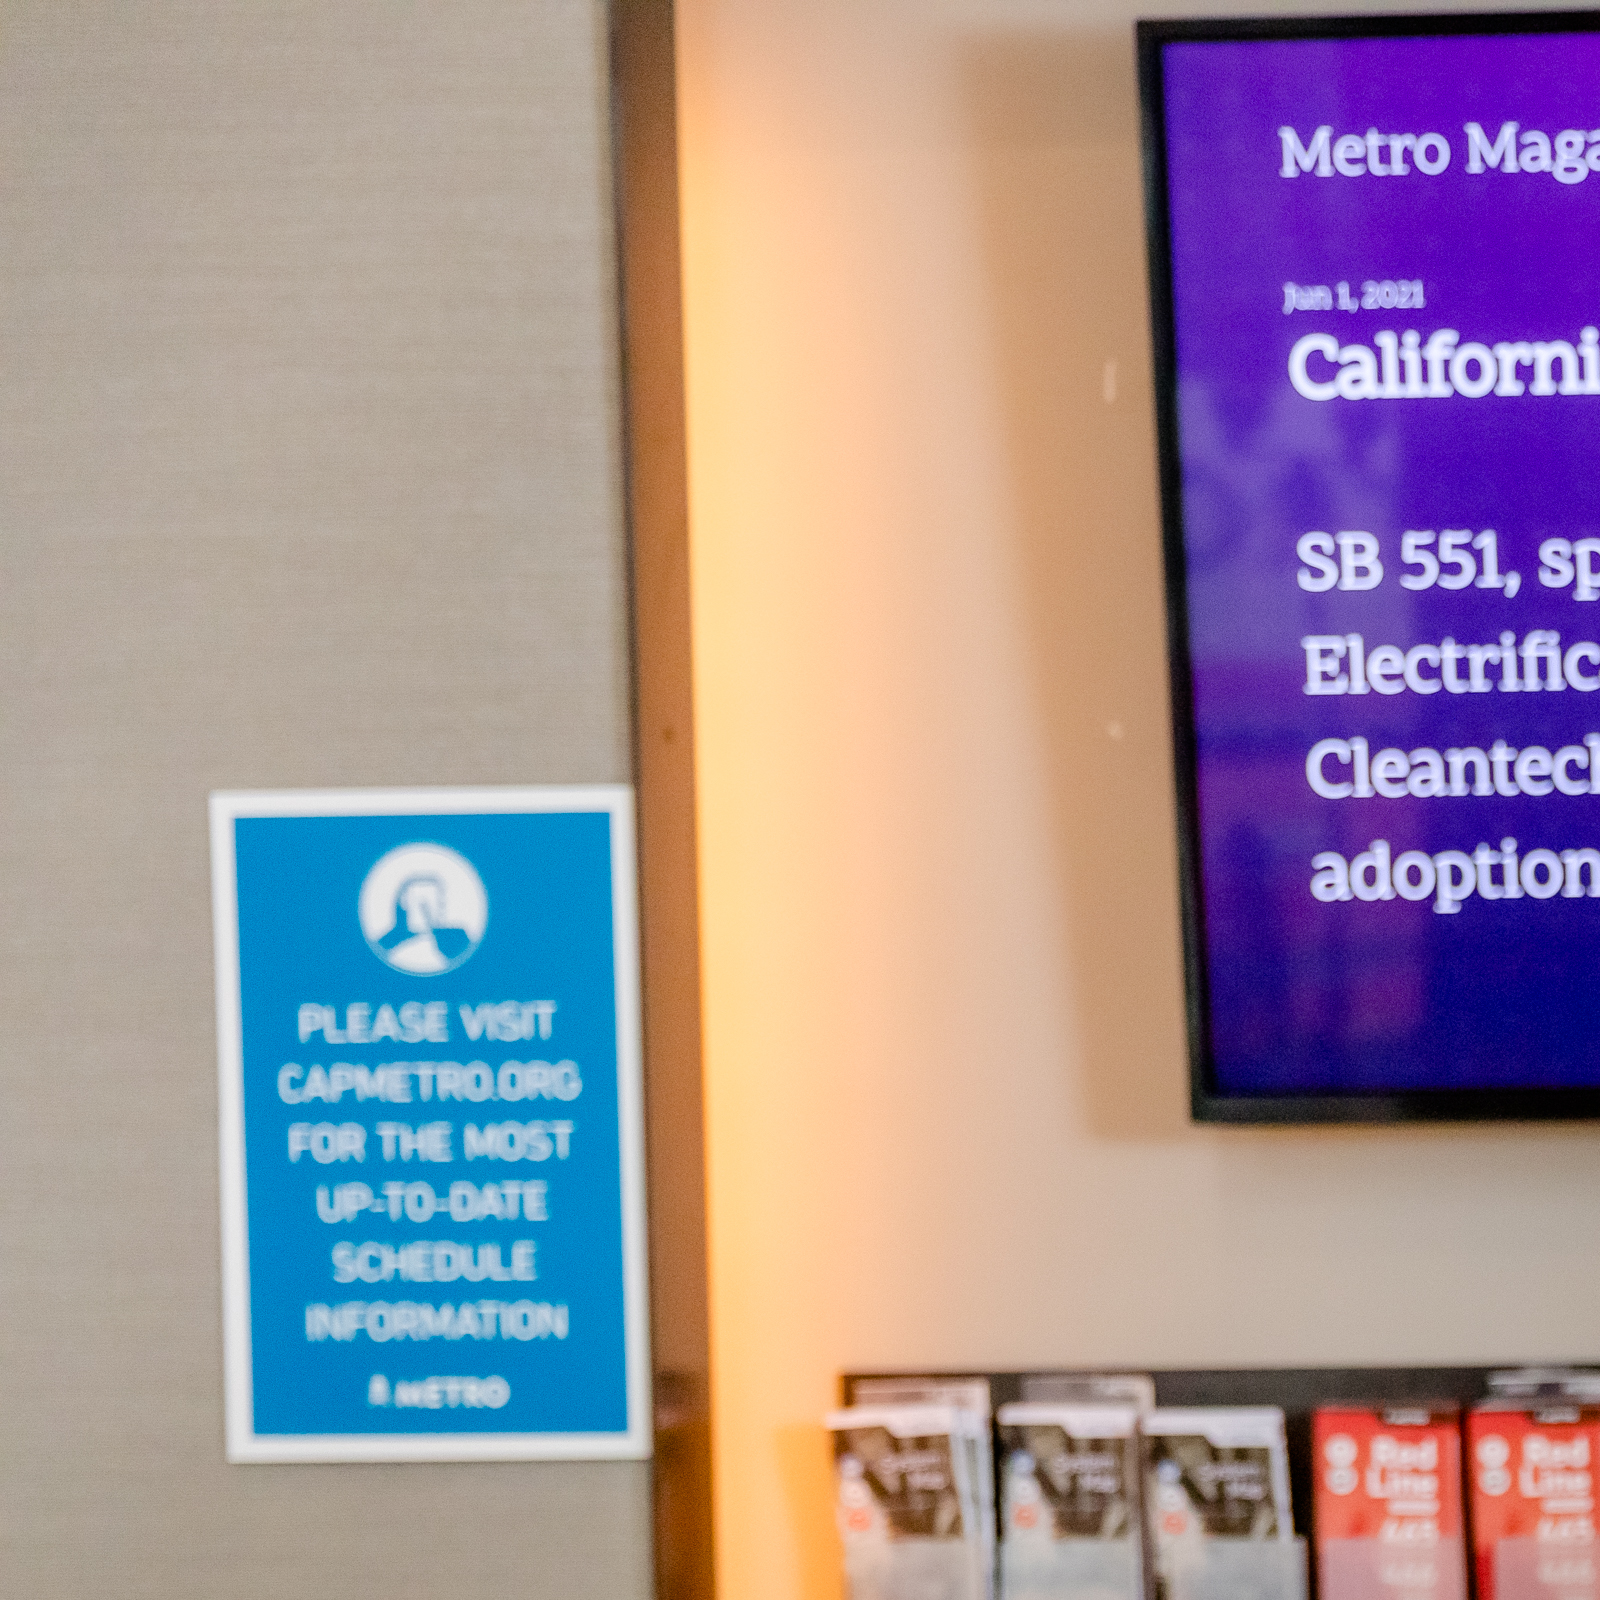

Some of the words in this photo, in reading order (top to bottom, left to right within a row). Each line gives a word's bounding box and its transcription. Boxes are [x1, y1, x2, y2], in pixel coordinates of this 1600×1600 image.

[1278, 125, 1450, 178] Metro
[1283, 281, 1333, 315] Jun
[1335, 280, 1359, 314] 1,
[1361, 279, 1426, 310] 2021
[1297, 530, 1384, 592] SB
[1399, 529, 1521, 599] 551,
[297, 1001, 450, 1044] PLEASE
[459, 1000, 558, 1042] VISIT
[277, 1060, 583, 1104] CAPMETRO.ORG
[287, 1122, 367, 1164] FOR
[376, 1120, 454, 1162] THE
[463, 1119, 576, 1162] MOST
[316, 1180, 550, 1223] UP-TO-DATE
[331, 1240, 538, 1283] SCHEDULE
[304, 1299, 570, 1342] INFORMATION
[395, 1375, 510, 1409] METRO
[1369, 1434, 1438, 1470] Red
[1521, 1434, 1590, 1468] Red
[1365, 1466, 1439, 1499] Line
[1518, 1465, 1593, 1498] Line
